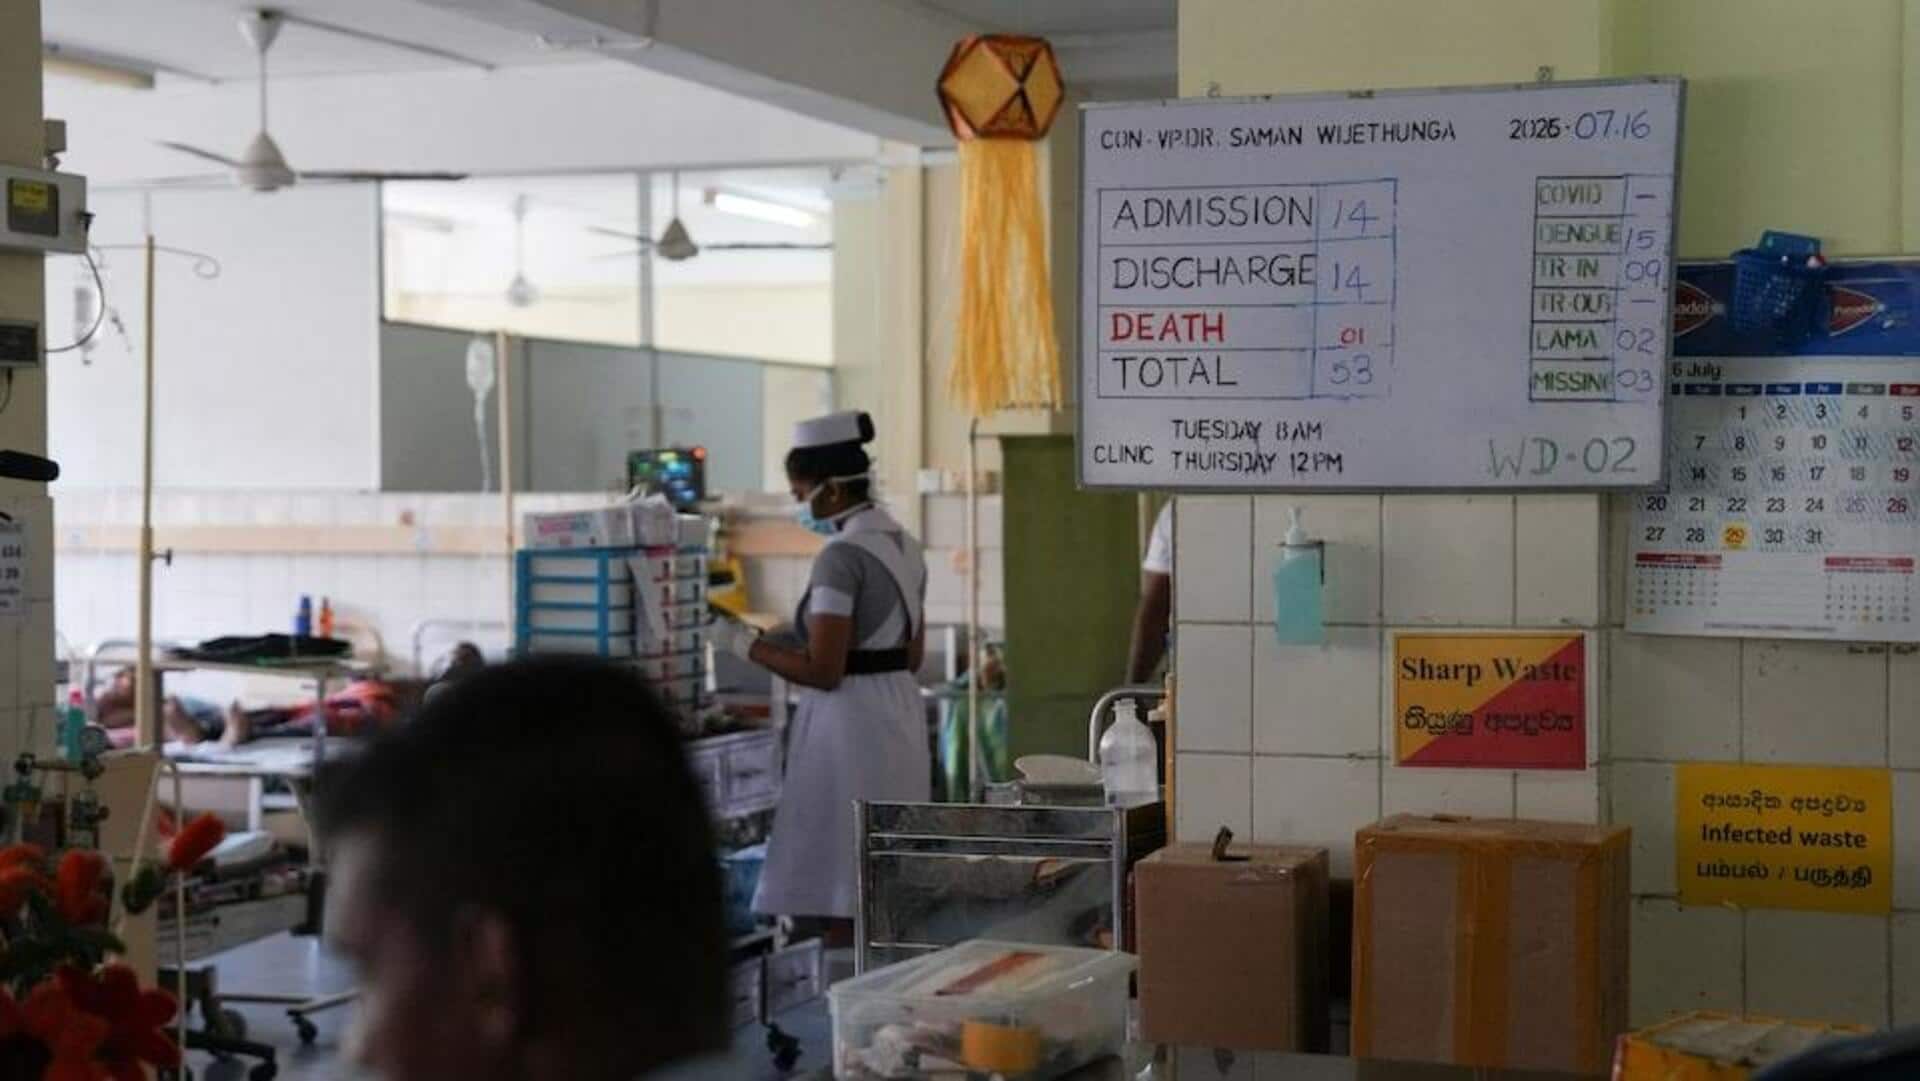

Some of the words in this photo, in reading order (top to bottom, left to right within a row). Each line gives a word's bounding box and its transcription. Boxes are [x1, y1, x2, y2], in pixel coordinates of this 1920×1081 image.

[1229, 126, 1303, 148] SAMAN
[1316, 119, 1457, 145] WIJETHUNGA
[1539, 183, 1602, 205] COVID
[1112, 195, 1314, 232] ADMISSION
[1333, 199, 1380, 233] 14
[1539, 223, 1621, 243] DENGUE
[1624, 227, 1657, 255] 15
[1112, 253, 1318, 290] DISCHARGE
[1333, 262, 1372, 299] 14
[1625, 258, 1662, 288] 09
[1109, 312, 1225, 342] DEATH
[1340, 327, 1365, 344] 01
[1535, 329, 1598, 352] LAMA
[1616, 327, 1656, 354] 02
[1111, 355, 1238, 389] TOTAL
[1330, 353, 1373, 385] 53
[1616, 368, 1654, 392] 03
[1686, 362, 1722, 380] July
[1737, 405, 1746, 420] 1
[1776, 404, 1786, 419] 2
[1815, 403, 1827, 419] 3
[1858, 405, 1868, 419] 4
[1902, 405, 1913, 420] 5
[1171, 418, 1263, 441] TUESDAY
[1094, 444, 1153, 465] CLINIC
[1695, 435, 1705, 449] 7
[1735, 435, 1745, 450] 8
[1775, 436, 1785, 450] 9
[1812, 435, 1827, 450] 10
[1897, 437, 1913, 451] 12
[1171, 451, 1276, 474] THURSDAY
[1691, 467, 1706, 481] 14
[1732, 467, 1747, 481] 15
[1771, 467, 1785, 481] 16
[1809, 467, 1825, 481] 17
[1893, 467, 1909, 482] 19
[1647, 497, 1667, 512] 20
[1688, 498, 1706, 512] 21
[1727, 498, 1747, 512] 22
[1766, 498, 1786, 513] 23
[1805, 498, 1824, 513] 24
[1645, 527, 1665, 542] 27
[1685, 528, 1705, 542] 28
[1725, 529, 1745, 544] 29
[1764, 529, 1783, 544] 30
[1804, 529, 1822, 544] 31
[1400, 656, 1481, 687] Sharp
[1491, 656, 1575, 681] Waste
[1701, 823, 1793, 845] Infected
[1799, 830, 1867, 849] waste
